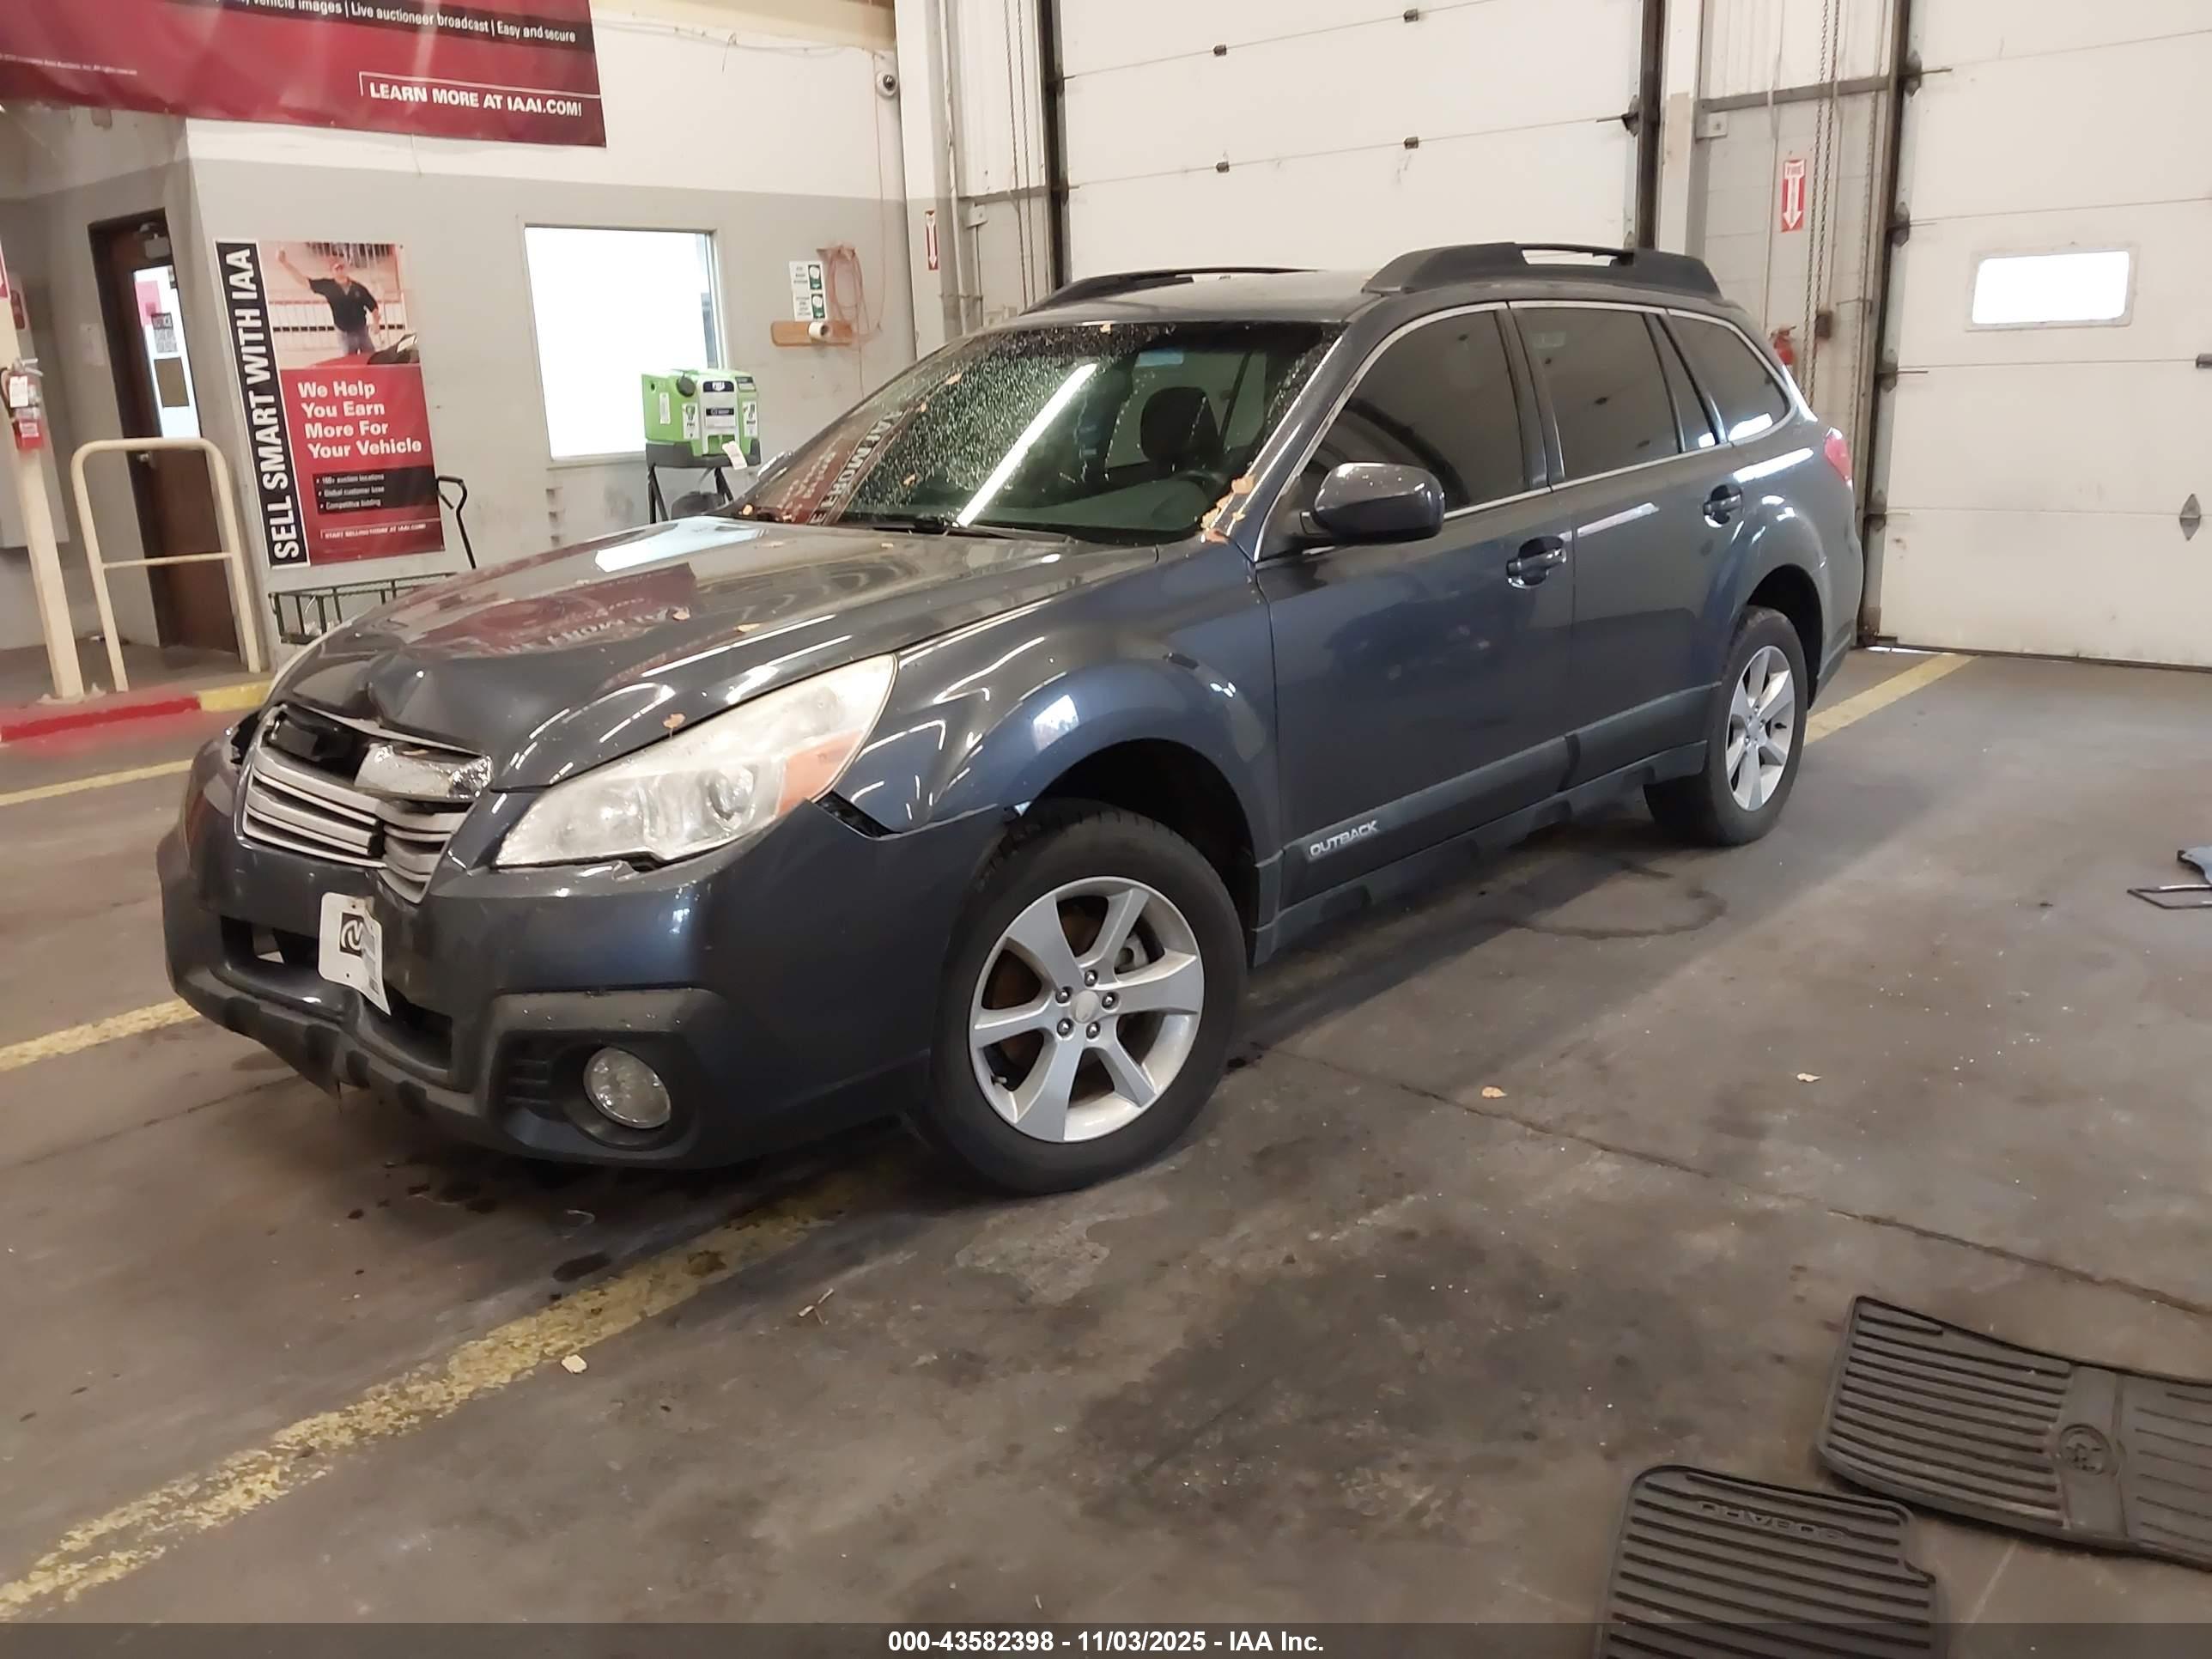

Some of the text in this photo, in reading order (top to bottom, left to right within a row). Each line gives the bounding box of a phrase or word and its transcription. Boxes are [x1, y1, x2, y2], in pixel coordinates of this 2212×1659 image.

[298, 0, 343, 15] images
[351, 1, 374, 18] Live
[376, 8, 434, 26] auctioneer
[437, 12, 489, 33] broadcast
[497, 21, 520, 40] Easy
[523, 26, 544, 39] and
[544, 30, 575, 43] secure
[370, 82, 582, 117] LEARN MORE AT IAAI.COM!
[225, 248, 300, 559] SELL SMART WITH IAA
[297, 380, 375, 399] We Help
[301, 400, 385, 418] You Earn
[305, 420, 388, 439] More For
[307, 437, 422, 459] Your Vehicle
[1310, 819, 1380, 857] OUTBACK
